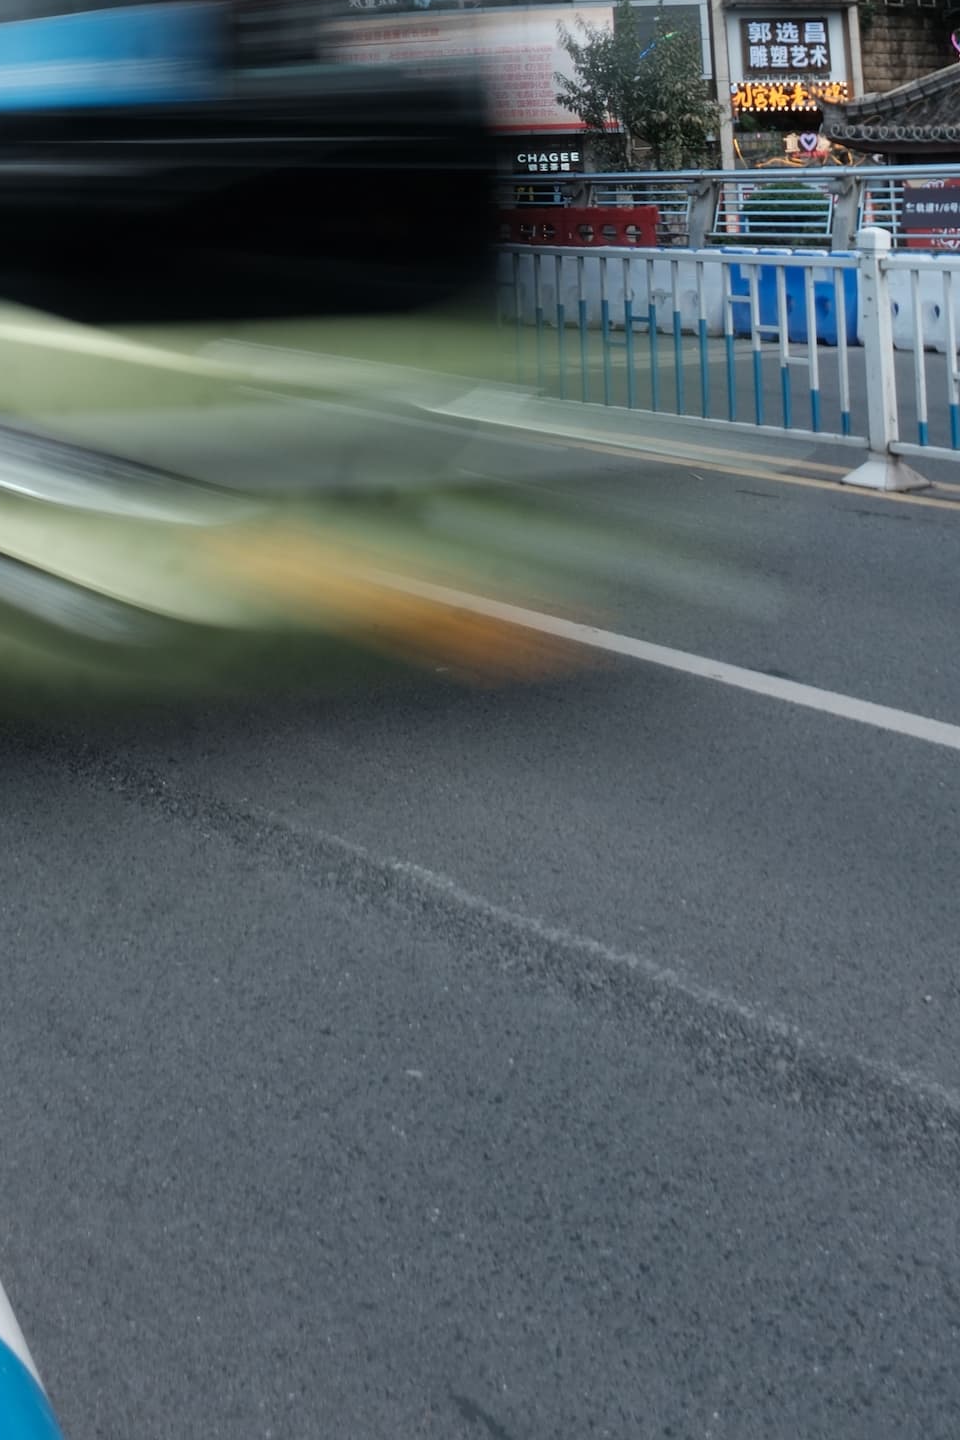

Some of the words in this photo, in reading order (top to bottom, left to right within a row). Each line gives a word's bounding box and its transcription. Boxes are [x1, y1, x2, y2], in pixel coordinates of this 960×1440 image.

[748, 22, 826, 43] 郭选昌
[750, 46, 828, 68] 雕塑艺术
[517, 152, 579, 163] CHAGEE
[916, 202, 960, 213] 轨道1/6号
